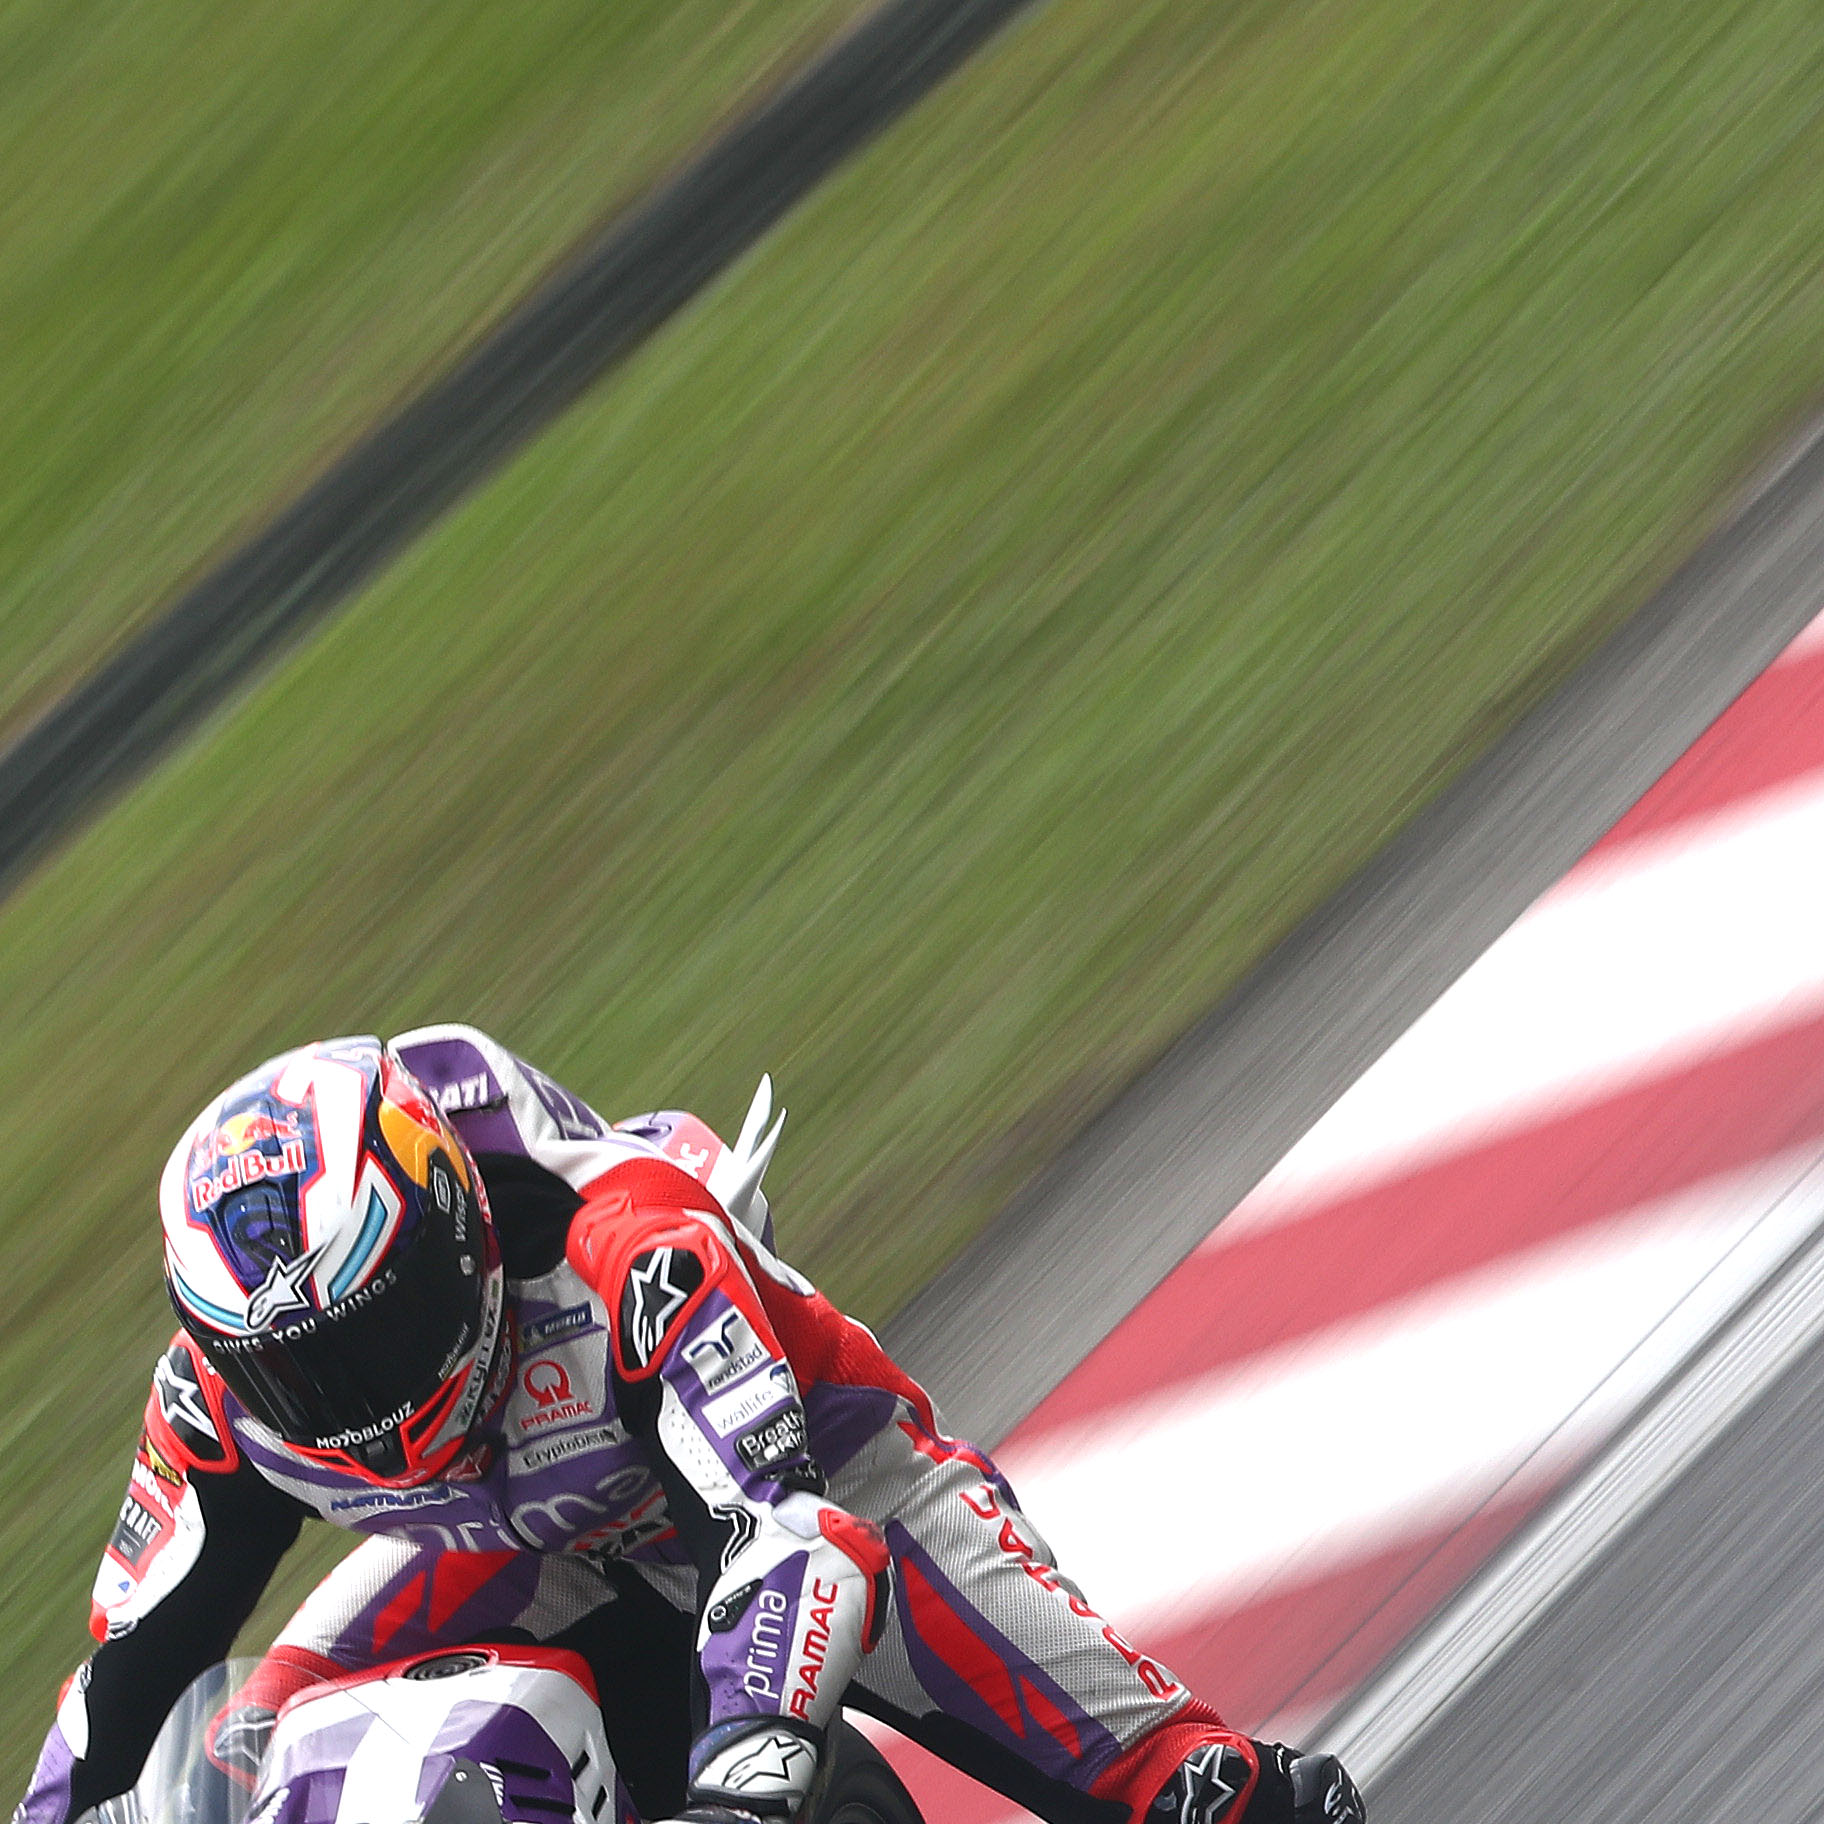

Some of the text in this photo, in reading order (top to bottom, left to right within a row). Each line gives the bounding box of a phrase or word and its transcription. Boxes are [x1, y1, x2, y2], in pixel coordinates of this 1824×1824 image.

[433, 1072, 488, 1107] ATI
[192, 1141, 306, 1212] Red Bull
[272, 1318, 316, 1344] YOU
[326, 1269, 397, 1322] WINGS
[708, 1344, 763, 1388] randstad
[520, 1401, 593, 1431] PRAMAC
[718, 1389, 774, 1430] wallife
[744, 1589, 788, 1699] prima
[788, 1577, 839, 1721] RAMAC
